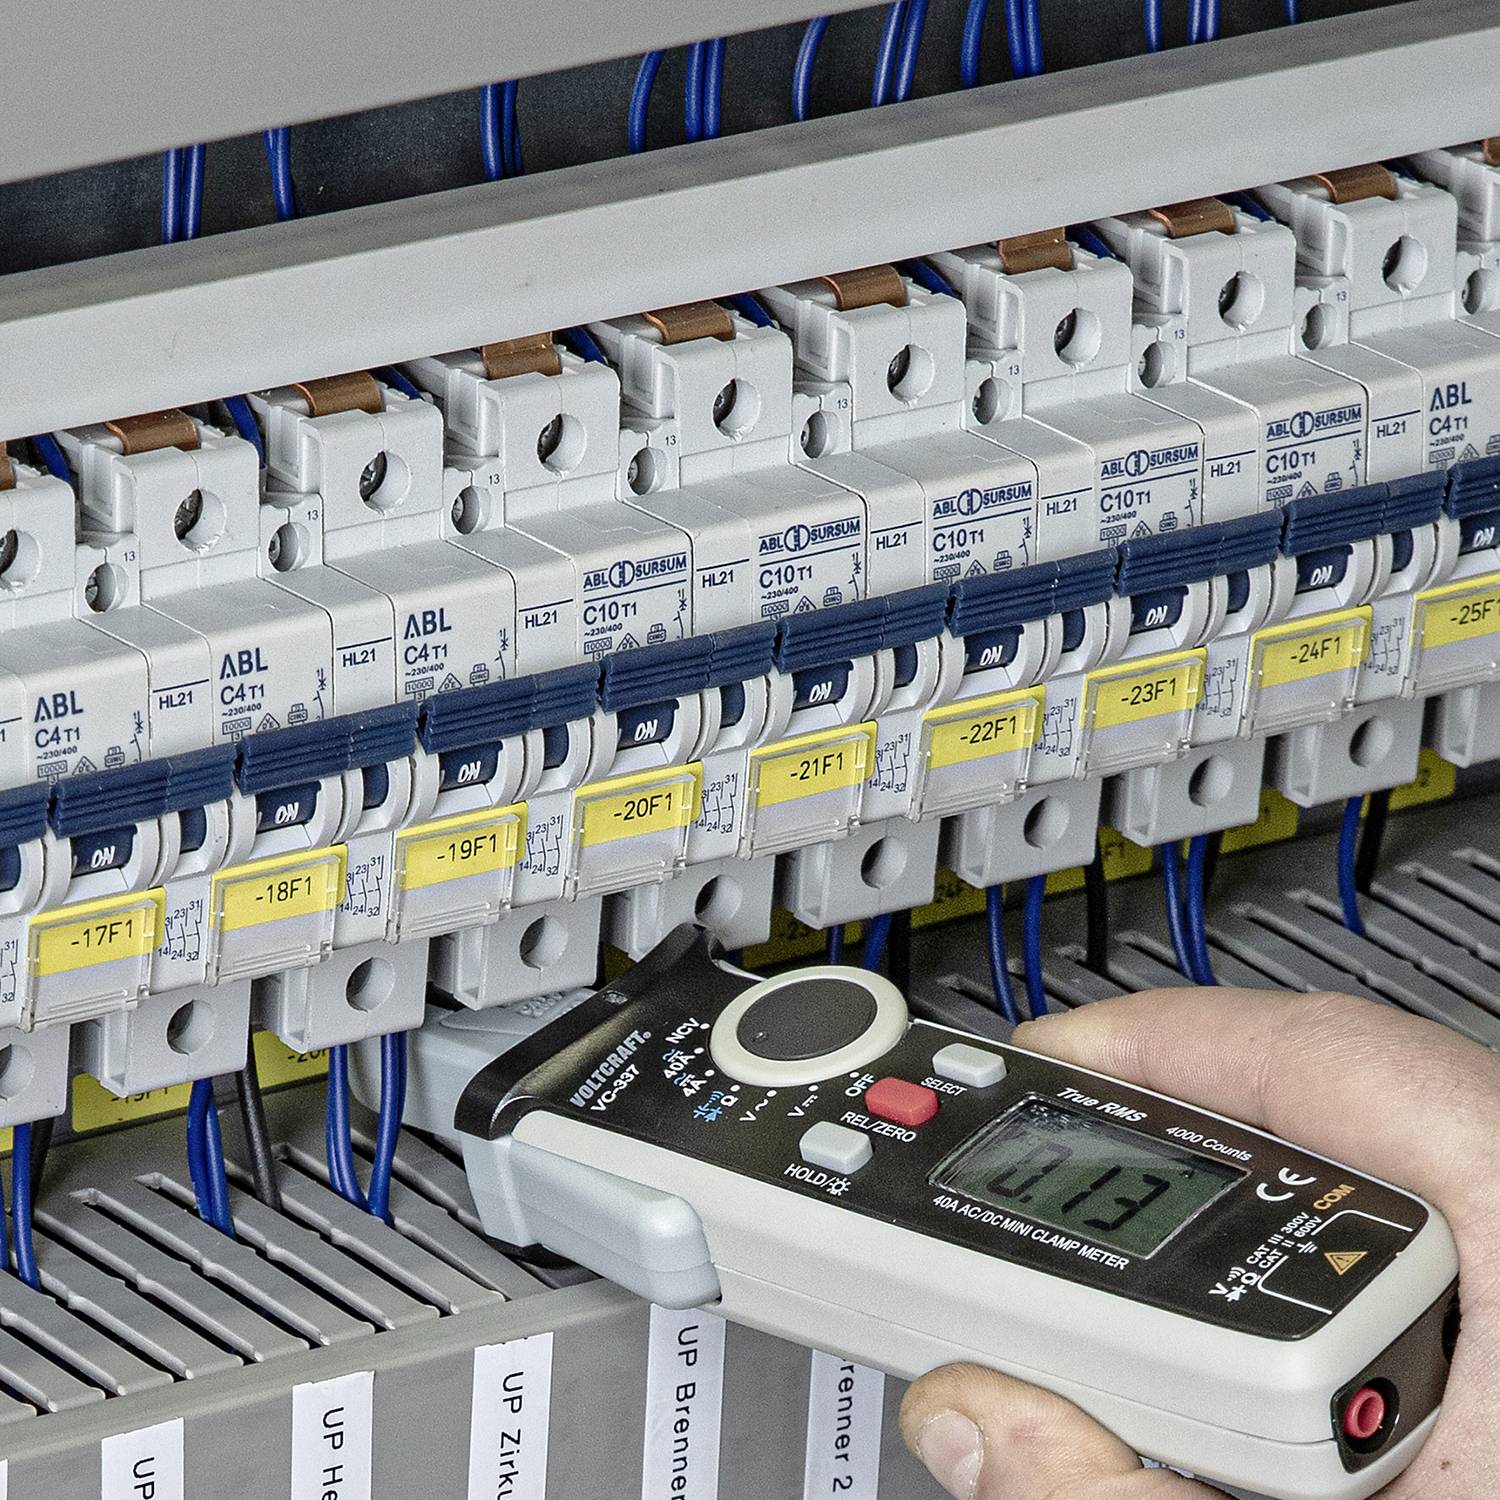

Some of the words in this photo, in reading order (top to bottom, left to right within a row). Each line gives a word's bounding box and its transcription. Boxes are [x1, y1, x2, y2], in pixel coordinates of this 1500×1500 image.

[1429, 382, 1472, 411] ABL
[1266, 422, 1289, 438] ABL
[1313, 407, 1362, 429] SURSUM
[1376, 421, 1406, 439] HL21
[1101, 461, 1124, 476] ABL
[1149, 445, 1199, 467] SURSUM
[1210, 461, 1241, 478] HL21
[933, 500, 957, 516] ABL
[983, 484, 1032, 506] SURSUM
[1046, 499, 1077, 516] HL21
[759, 536, 783, 552] ABL
[810, 519, 861, 542] SURSUM
[876, 532, 908, 549] HL21
[123, 551, 136, 562] 13
[584, 571, 608, 589] ABL
[634, 555, 687, 578] SURSUM
[702, 570, 734, 588] HL21
[404, 608, 451, 640] ABL
[524, 611, 558, 629] HL21
[219, 648, 268, 679] ABL
[342, 649, 377, 667] HL21
[979, 646, 1002, 666] ON
[1290, 636, 1341, 664] -24F1
[159, 691, 194, 709] HL21
[809, 681, 832, 702] ON
[1121, 679, 1177, 706] -23F1
[34, 691, 84, 722] ABL
[634, 719, 658, 741] ON
[960, 716, 1017, 744] -22F1
[457, 761, 481, 783] ON
[790, 752, 844, 781] -21F1
[274, 802, 299, 824] ON
[613, 792, 672, 821] -20F1
[91, 846, 115, 868] ON
[436, 834, 497, 862] -19F1
[255, 876, 312, 904] -18F1
[71, 919, 133, 948] -17F1
[665, 1018, 699, 1046] NCV
[664, 1052, 696, 1079] 40A
[591, 1064, 641, 1113] VC-337
[682, 1076, 707, 1098] 4A
[844, 1072, 874, 1097] OFF
[921, 1076, 967, 1096] SELECT
[1056, 1088, 1099, 1108] True
[1096, 1102, 1148, 1123] RMS
[839, 1111, 917, 1142] REL/ZERO
[1165, 1126, 1203, 1143] 4000
[1201, 1138, 1252, 1162] Counts
[1313, 1183, 1356, 1211] COM
[932, 1194, 961, 1211] 40A
[958, 1202, 1003, 1226] AC/DC
[1000, 1216, 1034, 1237] MINI
[1030, 1228, 1080, 1255] CLAMP
[1077, 1246, 1129, 1271] METER
[1246, 1244, 1271, 1266] CAT
[1281, 1211, 1309, 1235] 300V
[1259, 1251, 1284, 1269] CAT
[1294, 1216, 1323, 1238] 600V
[674, 1324, 700, 1368] UP
[501, 1370, 524, 1415] UP
[834, 1358, 856, 1463] renner
[321, 1407, 345, 1451] UP
[832, 1475, 854, 1493] 2
